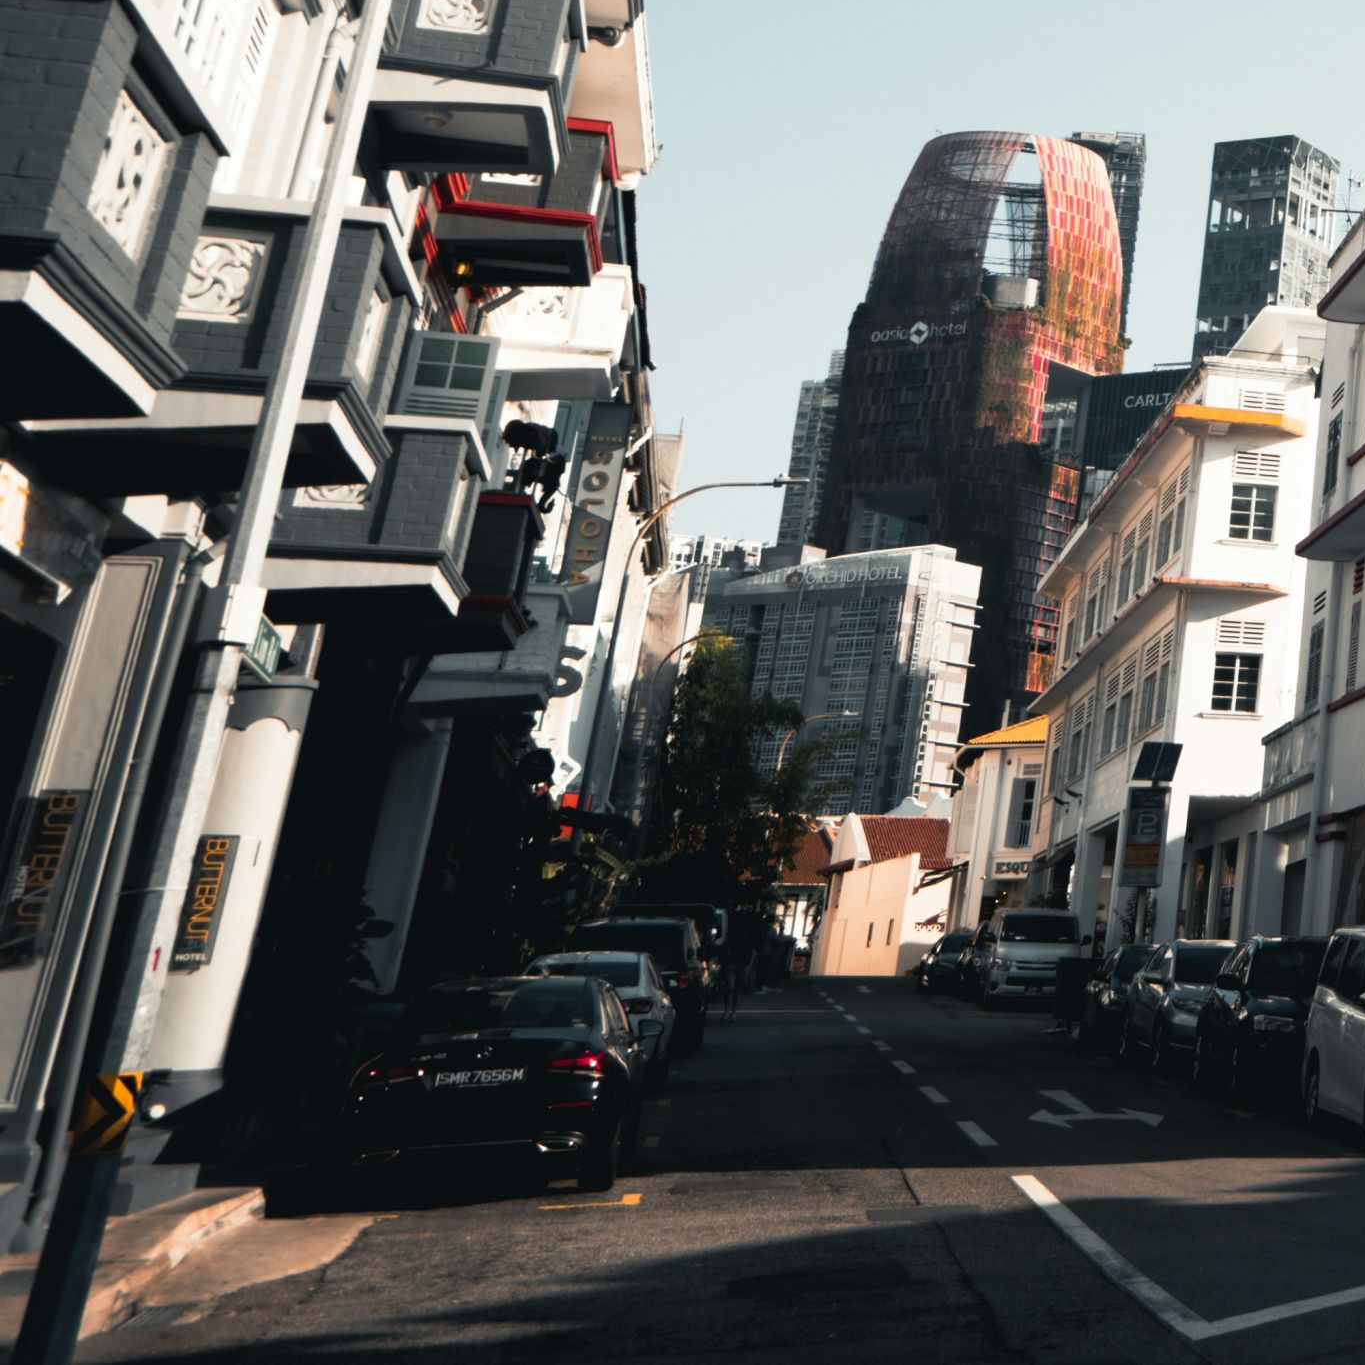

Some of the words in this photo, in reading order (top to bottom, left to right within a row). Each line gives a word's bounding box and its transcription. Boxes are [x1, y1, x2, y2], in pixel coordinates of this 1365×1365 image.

[930, 319, 968, 337] hotel
[858, 566, 904, 583] HOTEL
[14, 792, 81, 934] BUTTERNUT
[182, 836, 231, 945] BUTTERNUT
[174, 951, 207, 963] HOTEL
[438, 1068, 522, 1087] SMR7656M
